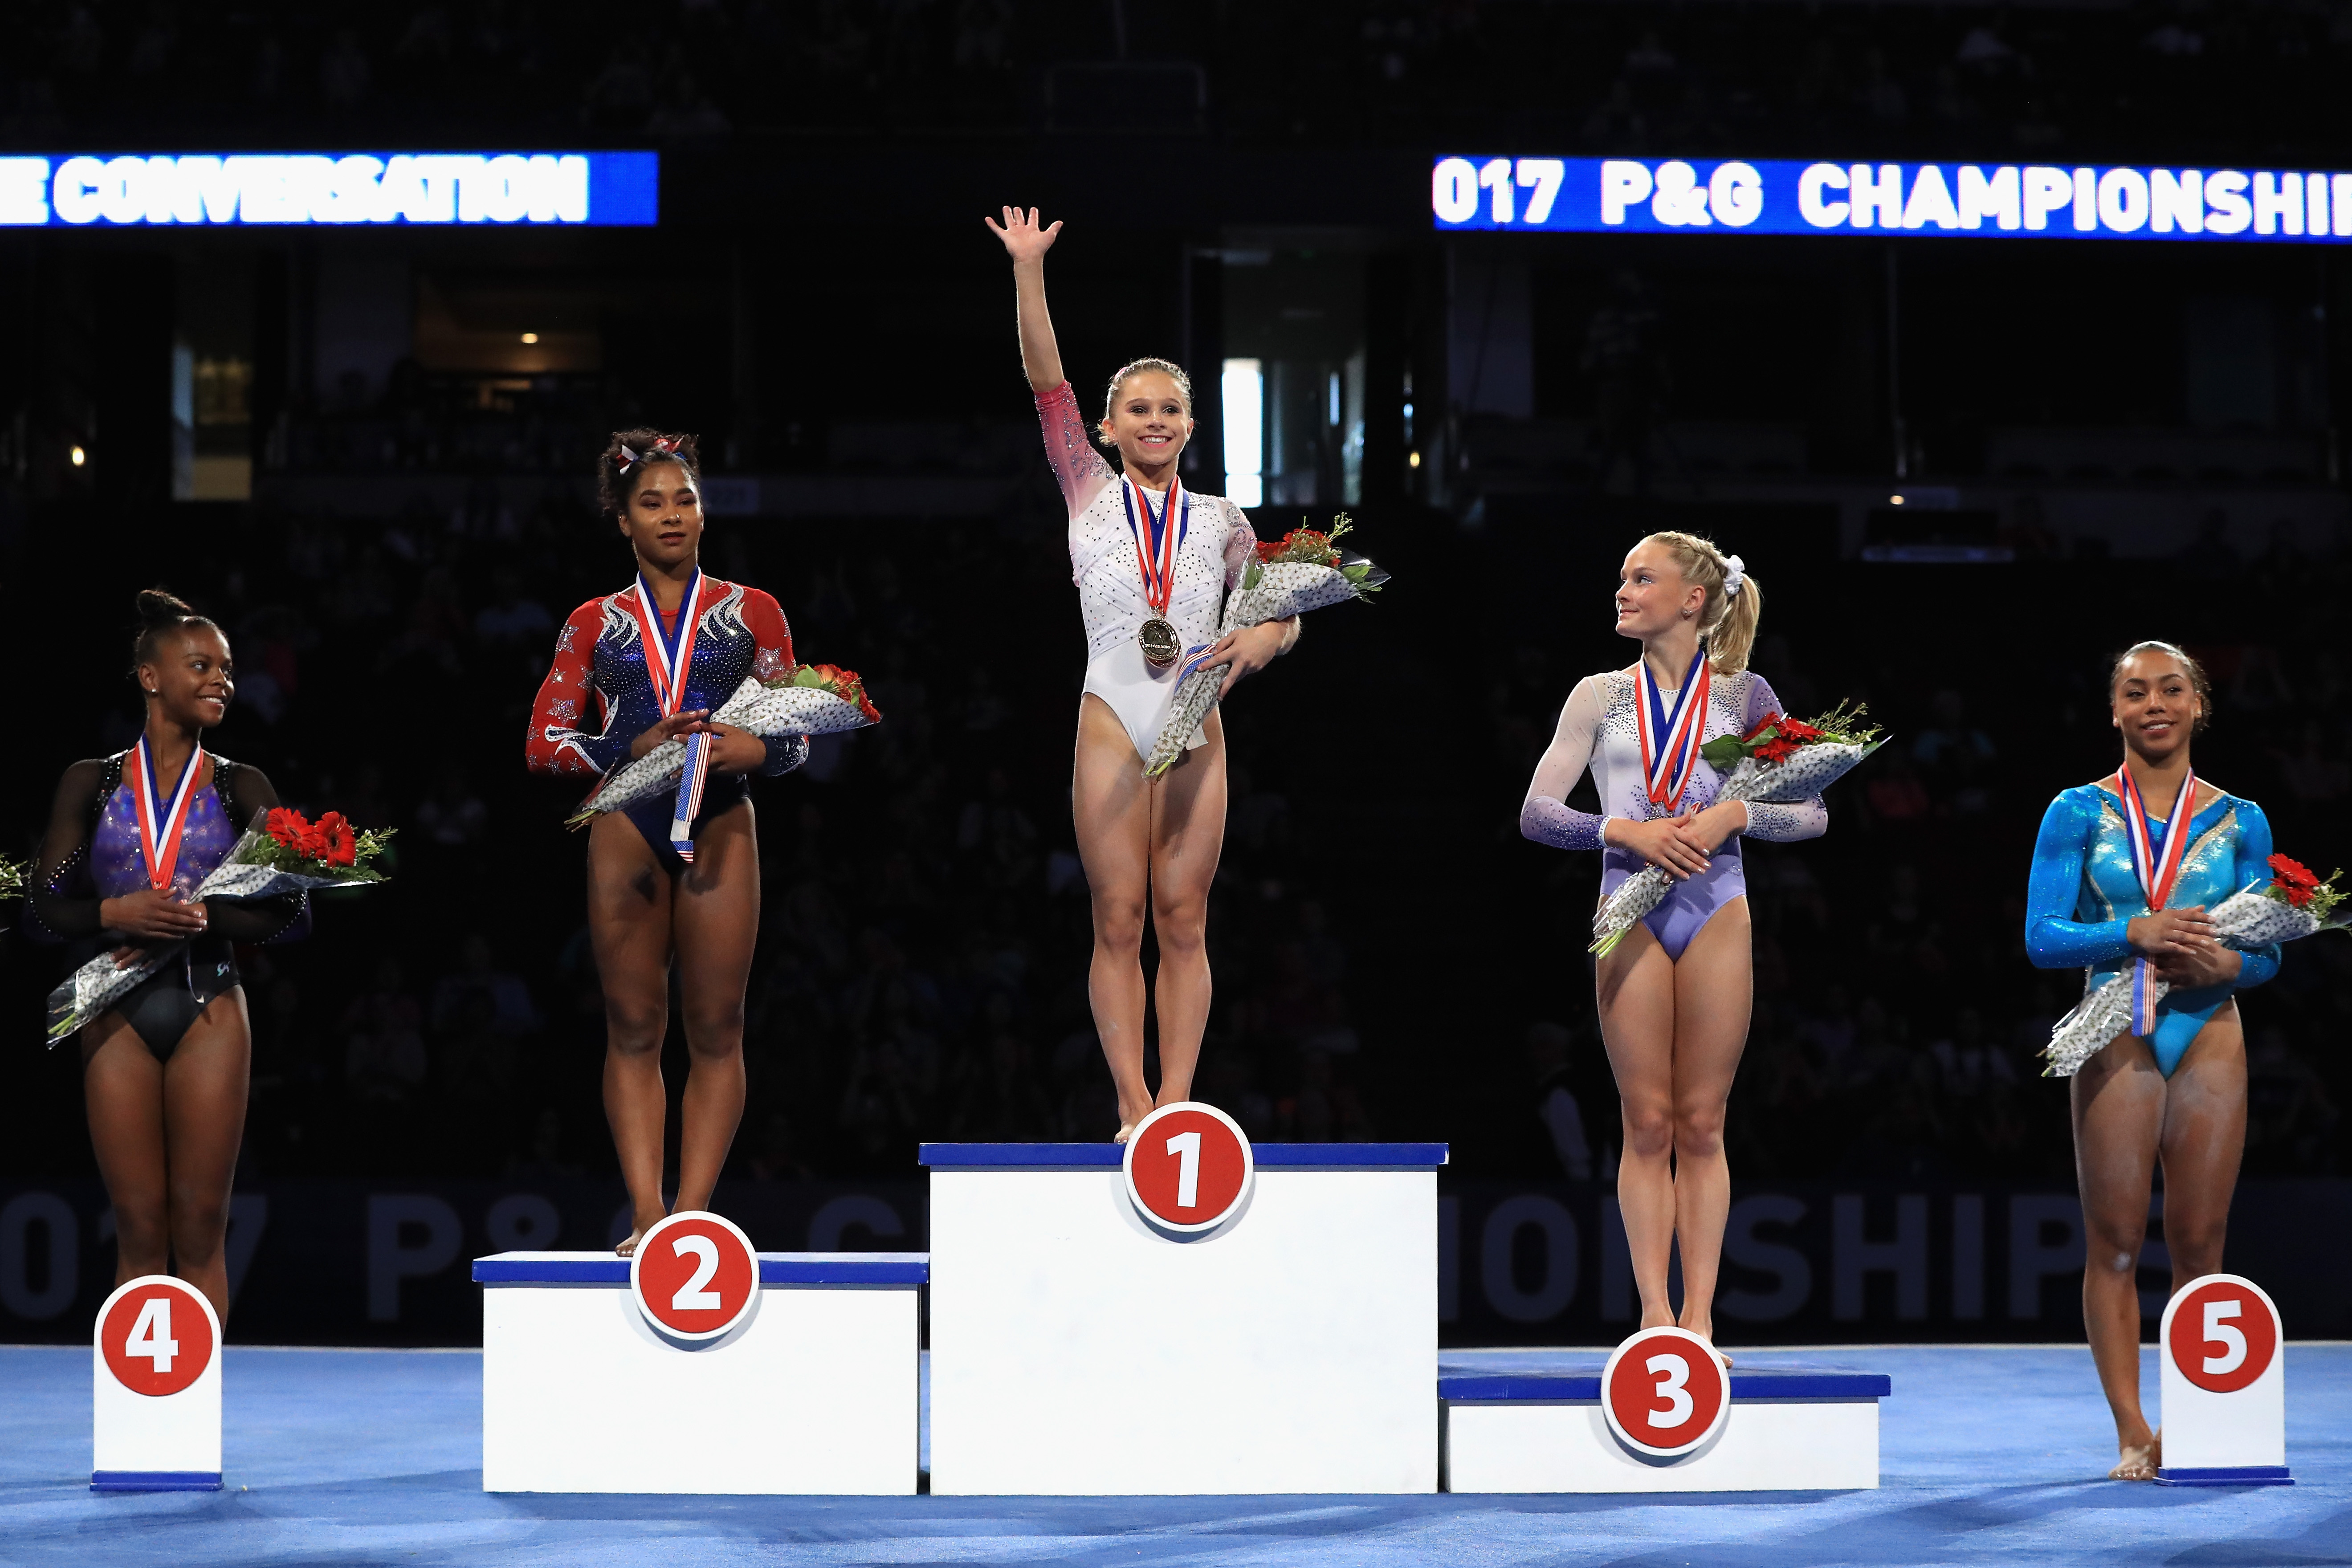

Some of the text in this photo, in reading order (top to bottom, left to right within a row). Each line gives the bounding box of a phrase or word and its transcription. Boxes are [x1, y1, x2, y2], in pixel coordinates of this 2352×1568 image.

[0, 155, 587, 224] E CONVERSATION
[1432, 158, 1564, 223] 017
[1601, 160, 1763, 227] P&G
[1166, 1132, 1202, 1208] 1
[0, 1190, 268, 1321] 07
[672, 1234, 721, 1311] 2
[125, 1298, 179, 1373] 4
[2202, 1299, 2248, 1375] 5
[1645, 1353, 1694, 1429] 3
